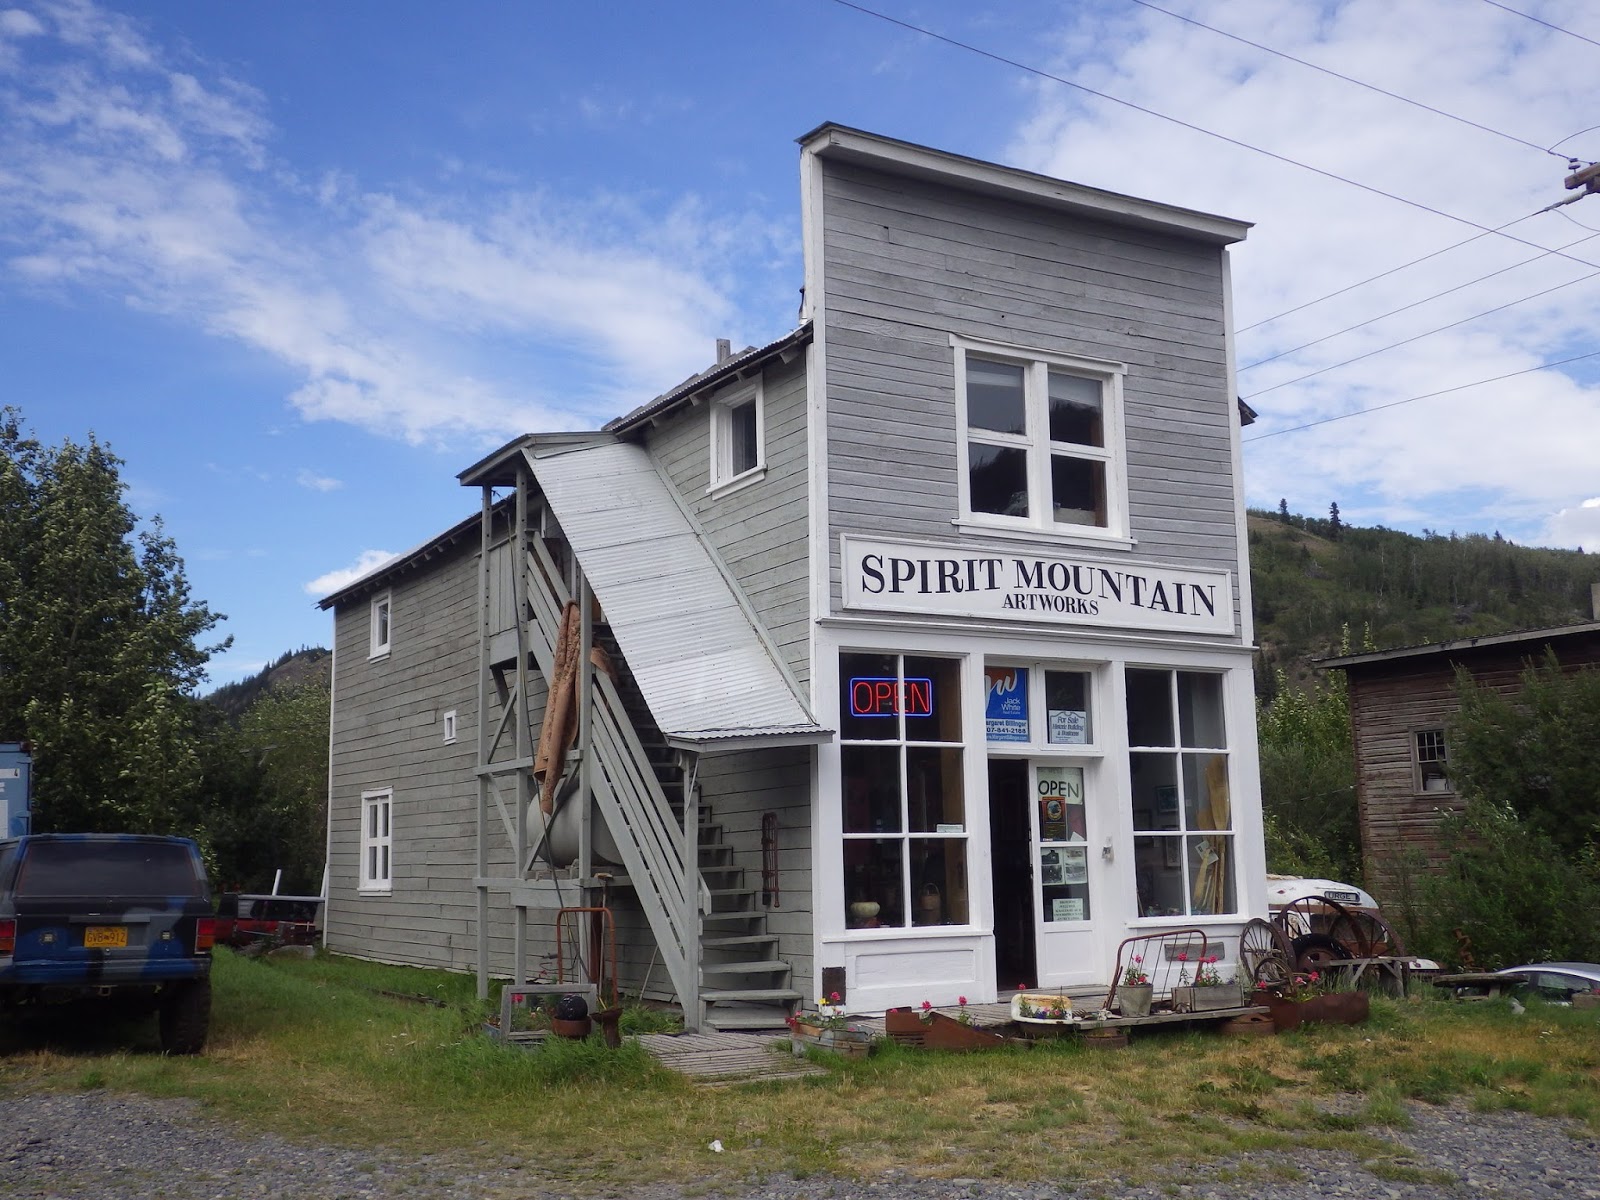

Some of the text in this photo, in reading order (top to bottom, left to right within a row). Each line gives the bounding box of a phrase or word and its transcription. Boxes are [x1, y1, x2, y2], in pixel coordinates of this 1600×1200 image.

[861, 554, 1216, 617] SPIRIT MOUNTAIN
[1002, 593, 1099, 615] ARTWORKS
[853, 682, 930, 713] OPEN
[1004, 697, 1020, 705] Jack
[986, 720, 1004, 728] argaret
[1068, 716, 1079, 724] Sale
[1038, 780, 1079, 798] OPEN
